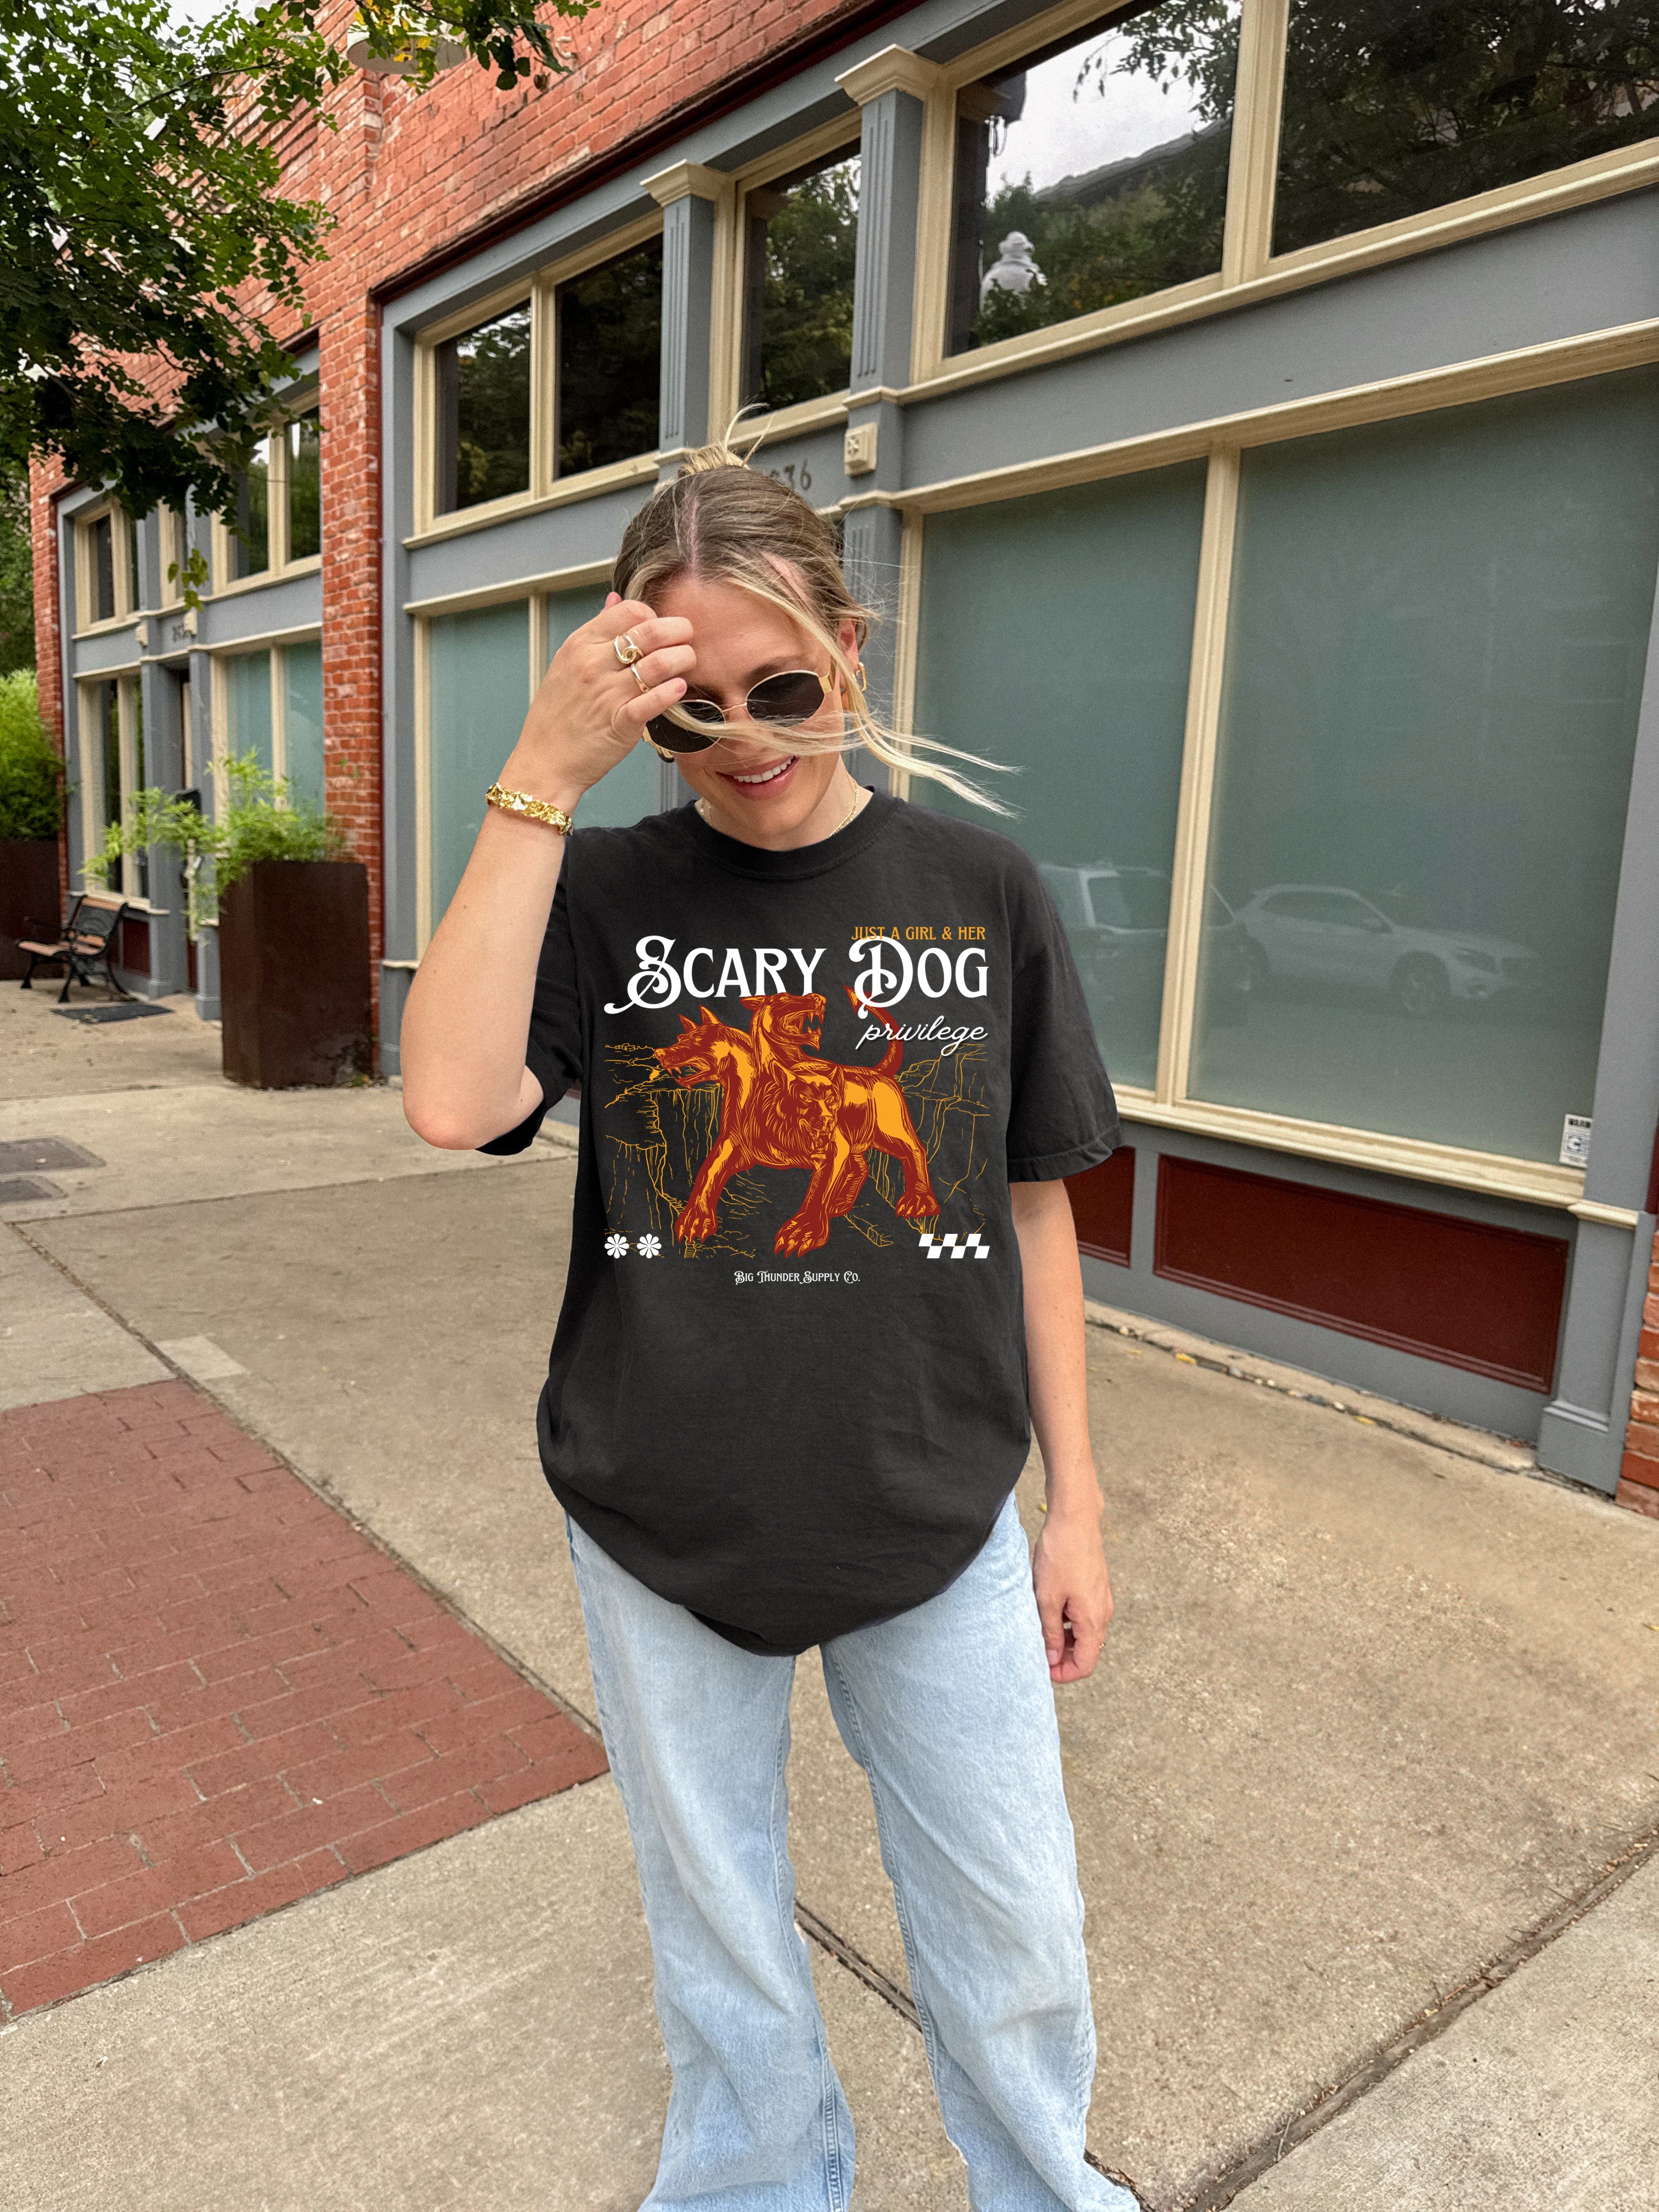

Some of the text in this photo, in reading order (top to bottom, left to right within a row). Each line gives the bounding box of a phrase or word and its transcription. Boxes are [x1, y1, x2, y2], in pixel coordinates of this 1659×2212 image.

[851, 926, 986, 940] JUST A GIRL & HER
[855, 1015, 988, 1057] privilege
